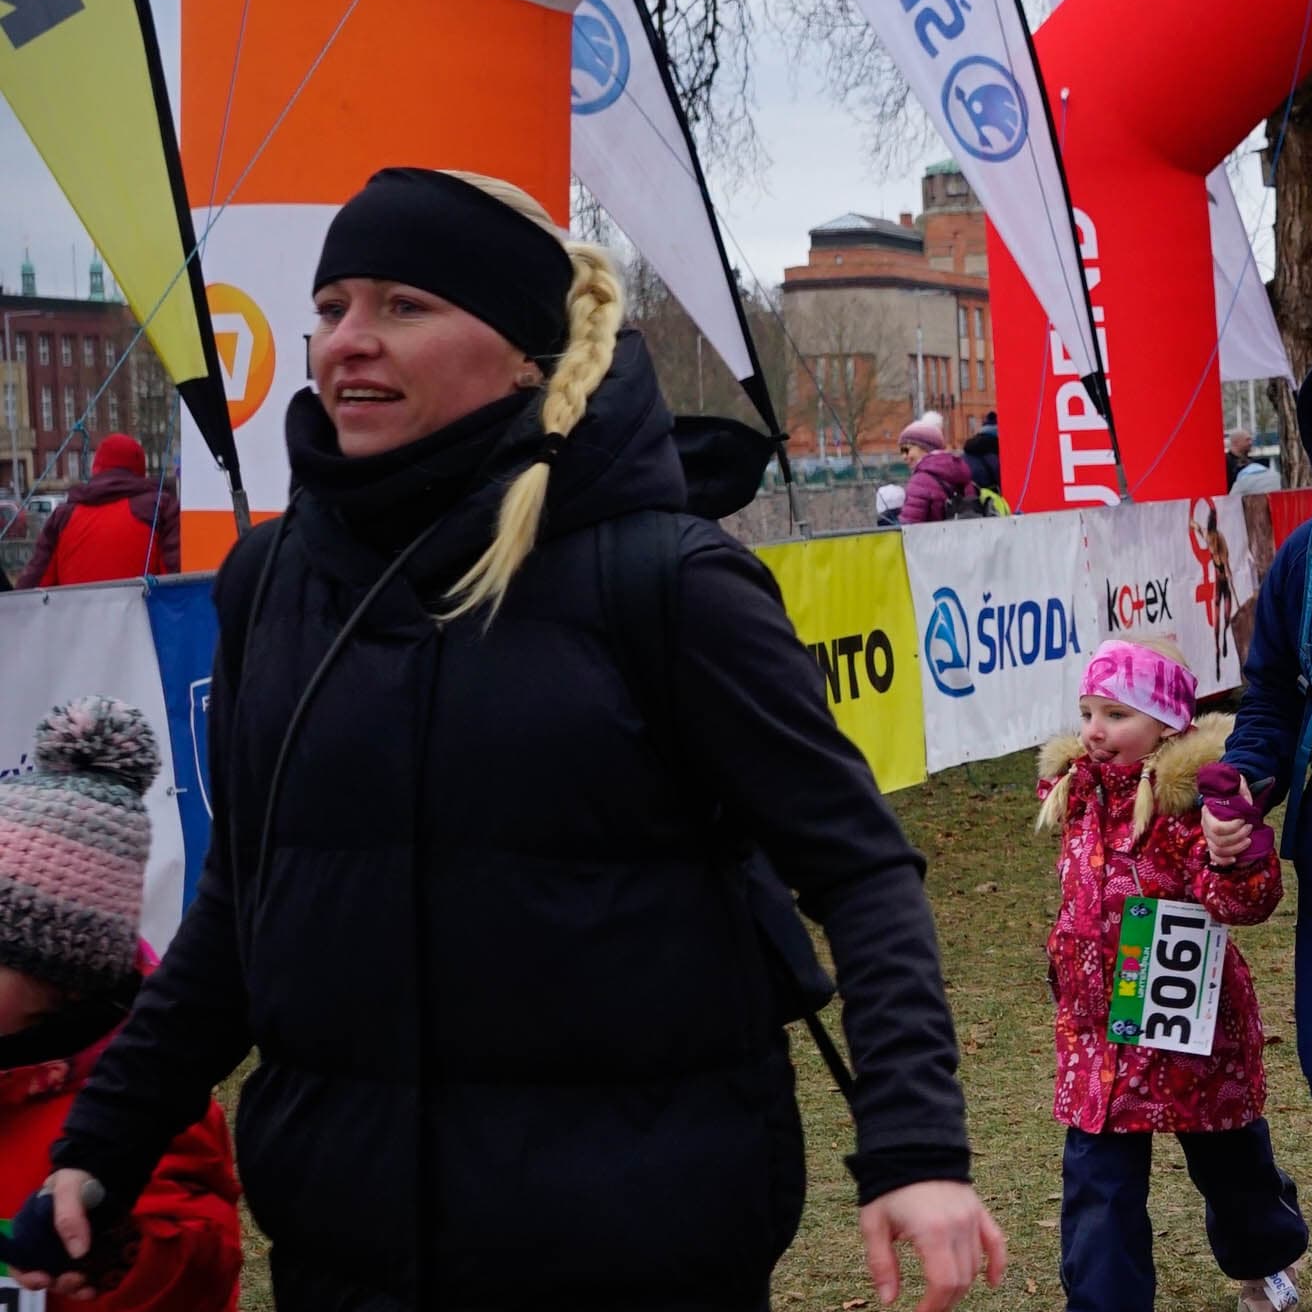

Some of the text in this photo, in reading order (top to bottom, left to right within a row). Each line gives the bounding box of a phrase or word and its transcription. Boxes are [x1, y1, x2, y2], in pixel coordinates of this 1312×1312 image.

[977, 592, 1081, 675] ŠKODA
[1106, 577, 1173, 632] kotex
[806, 629, 895, 705] NTO
[1145, 914, 1207, 1045] 3061
